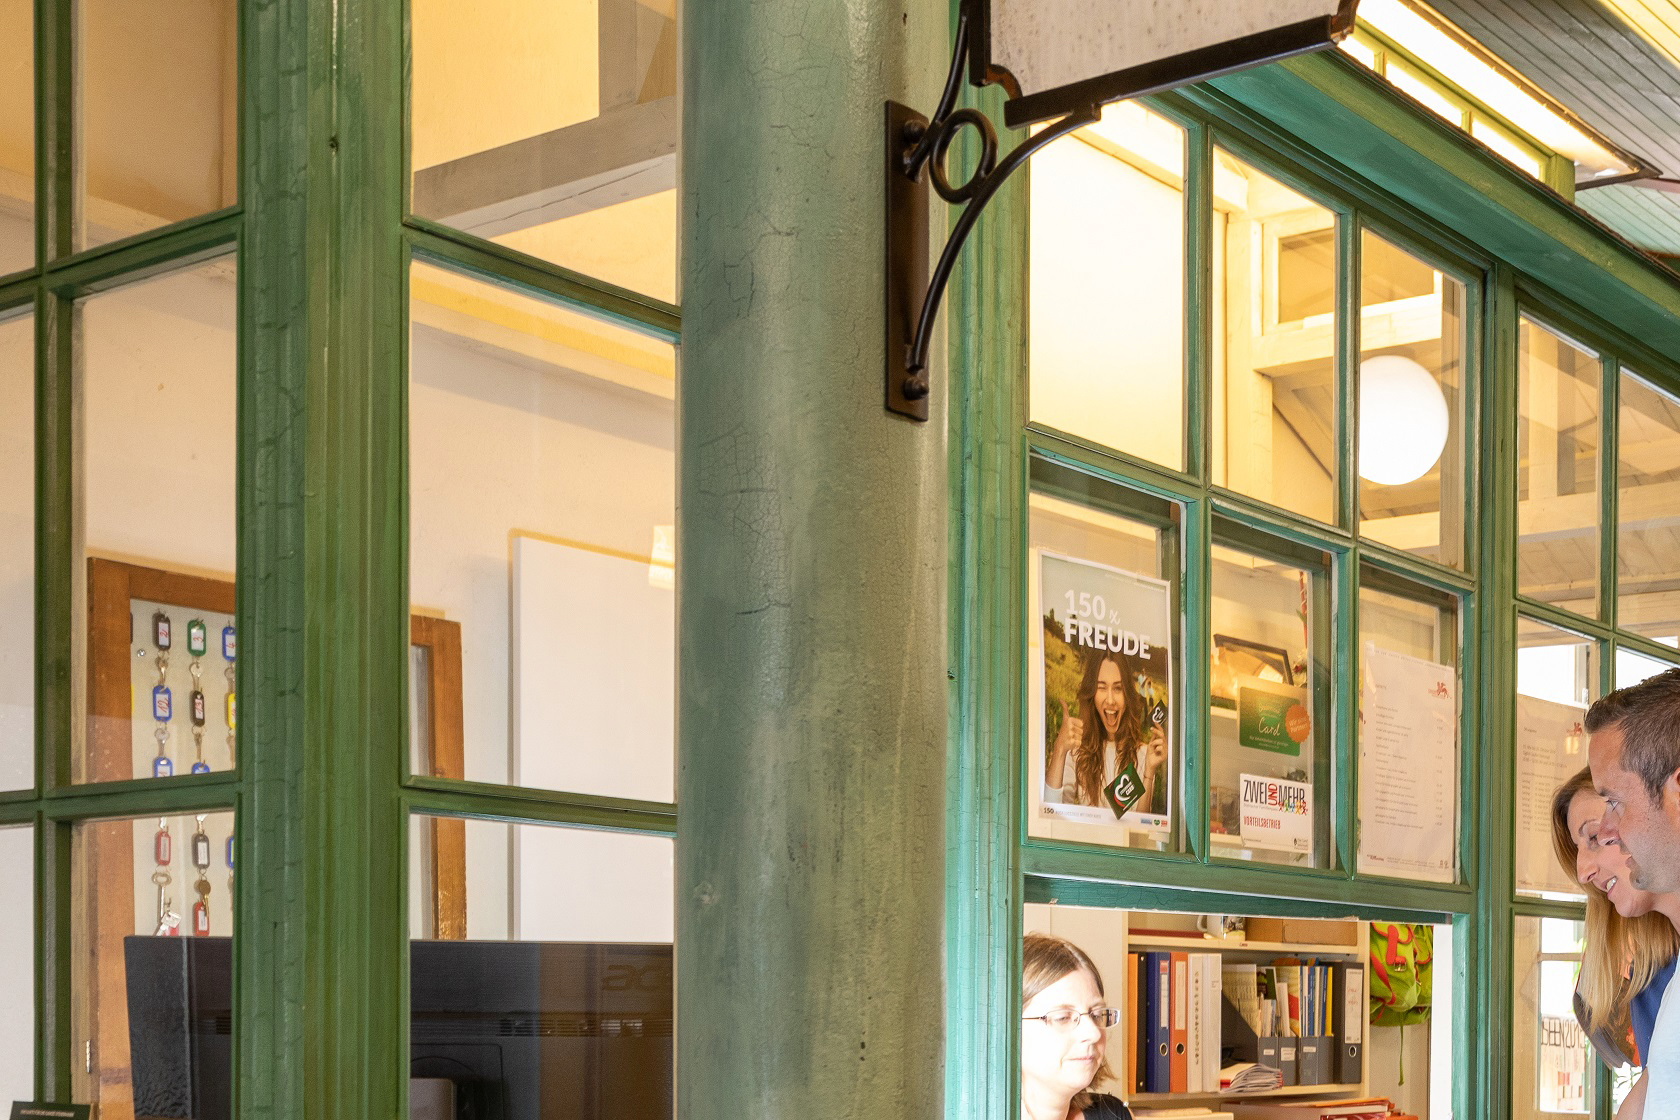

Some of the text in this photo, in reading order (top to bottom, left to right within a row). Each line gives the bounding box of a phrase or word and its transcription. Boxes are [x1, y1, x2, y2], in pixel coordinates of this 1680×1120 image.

[1064, 589, 1106, 621] 150
[1064, 618, 1151, 660] FREUDE
[1258, 716, 1281, 737] Card
[1243, 779, 1305, 806] ZWEI UND MEHR
[1243, 815, 1281, 830] VORTEILSBETRIEB
